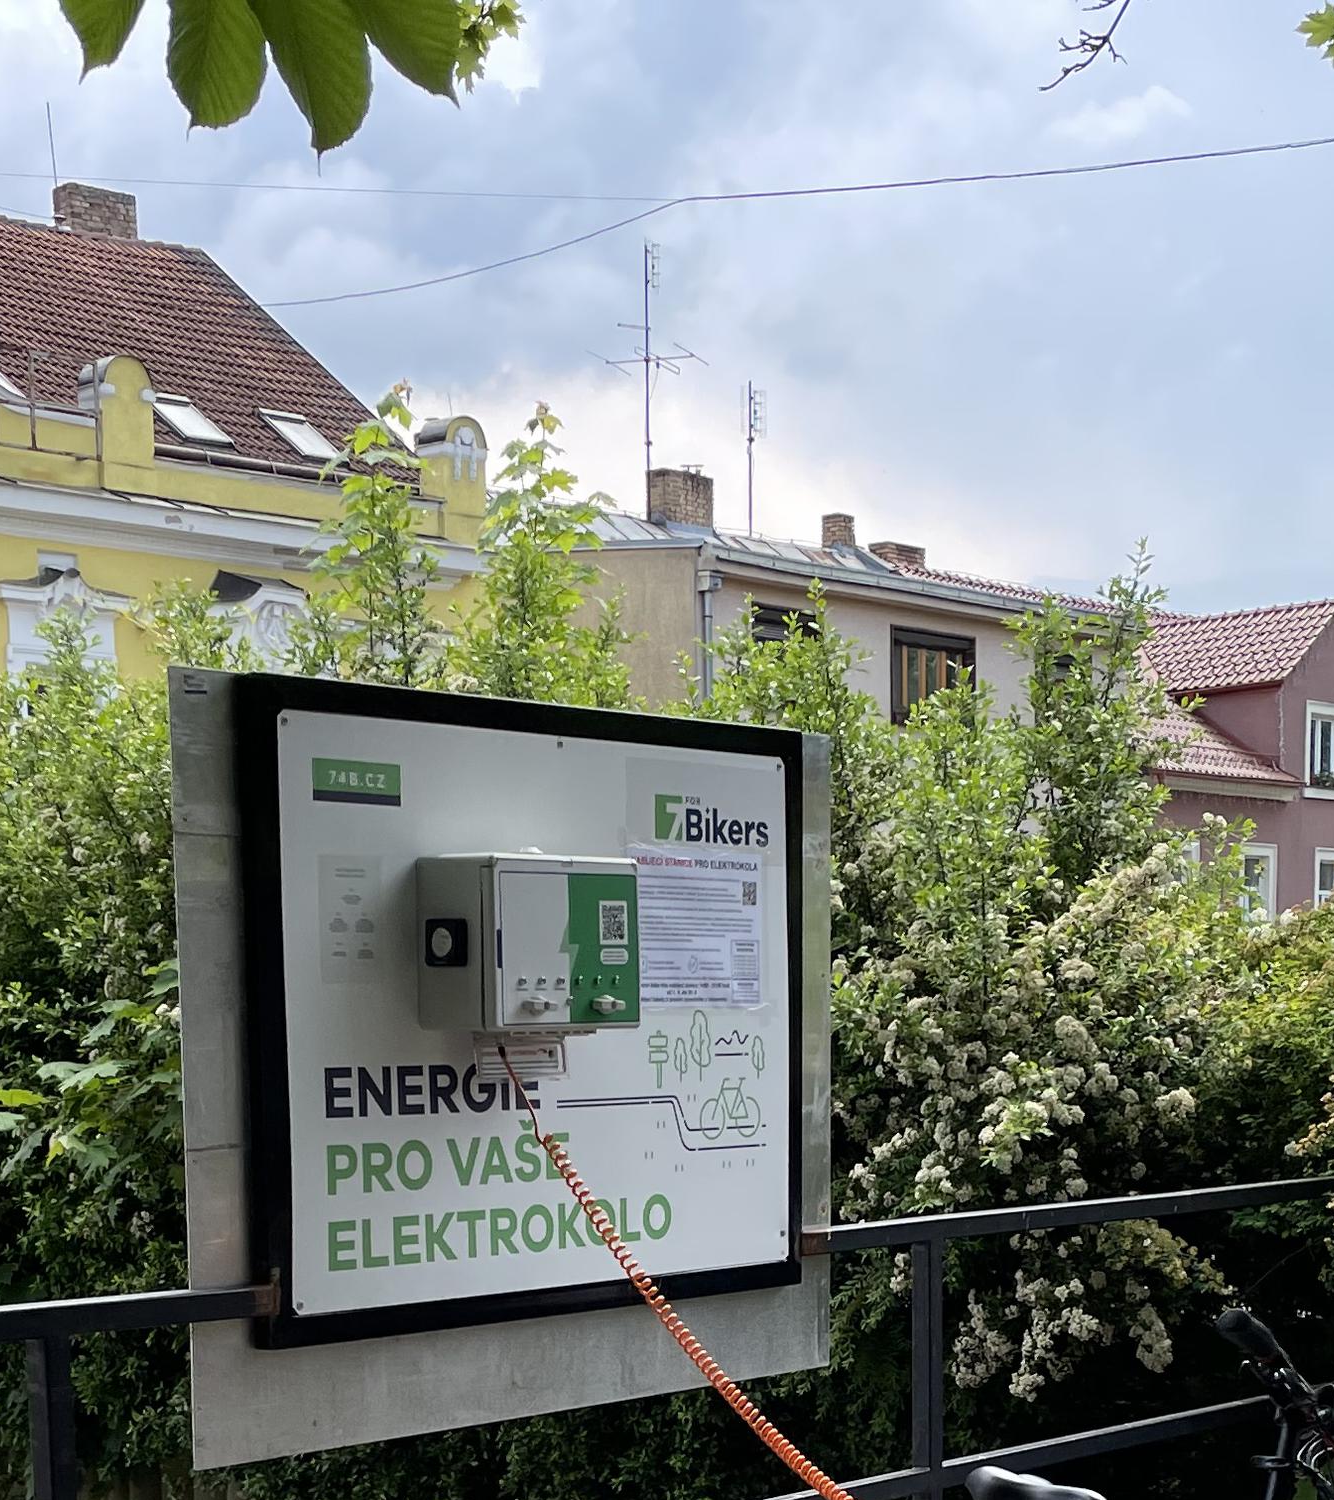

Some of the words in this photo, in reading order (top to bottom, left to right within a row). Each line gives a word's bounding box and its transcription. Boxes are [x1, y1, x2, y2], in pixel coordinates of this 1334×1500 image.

[685, 807, 769, 848] Bikers
[324, 1064, 541, 1119] ENERGIE
[326, 1139, 433, 1196] PRO
[446, 1119, 570, 1187] VAŠE
[328, 1193, 672, 1272] ELEKTROKOLO
